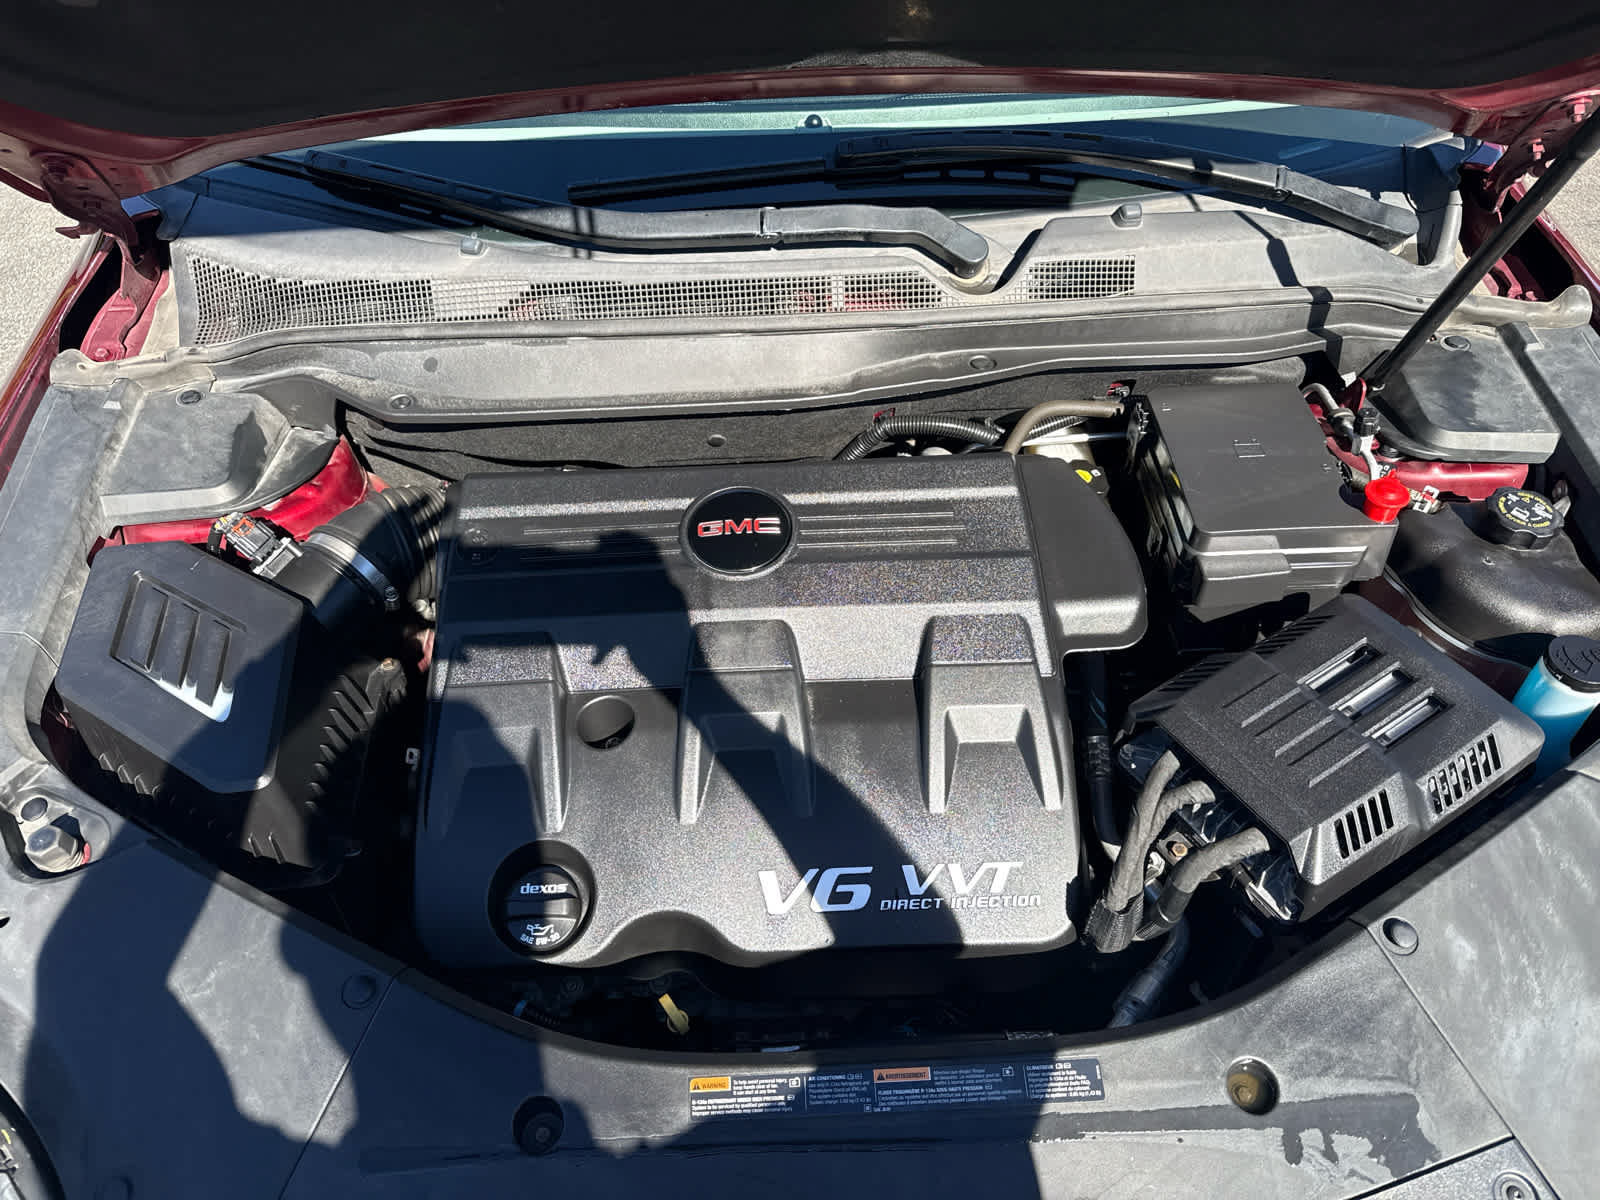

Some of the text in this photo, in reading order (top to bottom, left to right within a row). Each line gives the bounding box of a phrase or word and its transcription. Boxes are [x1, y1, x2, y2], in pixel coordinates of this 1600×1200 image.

[697, 517, 781, 537] GMC
[901, 861, 1024, 896] VVT
[520, 883, 568, 894] dexos
[758, 866, 873, 914] V6
[880, 894, 1041, 911] DIRECT INJECTION
[520, 933, 534, 945] SAE
